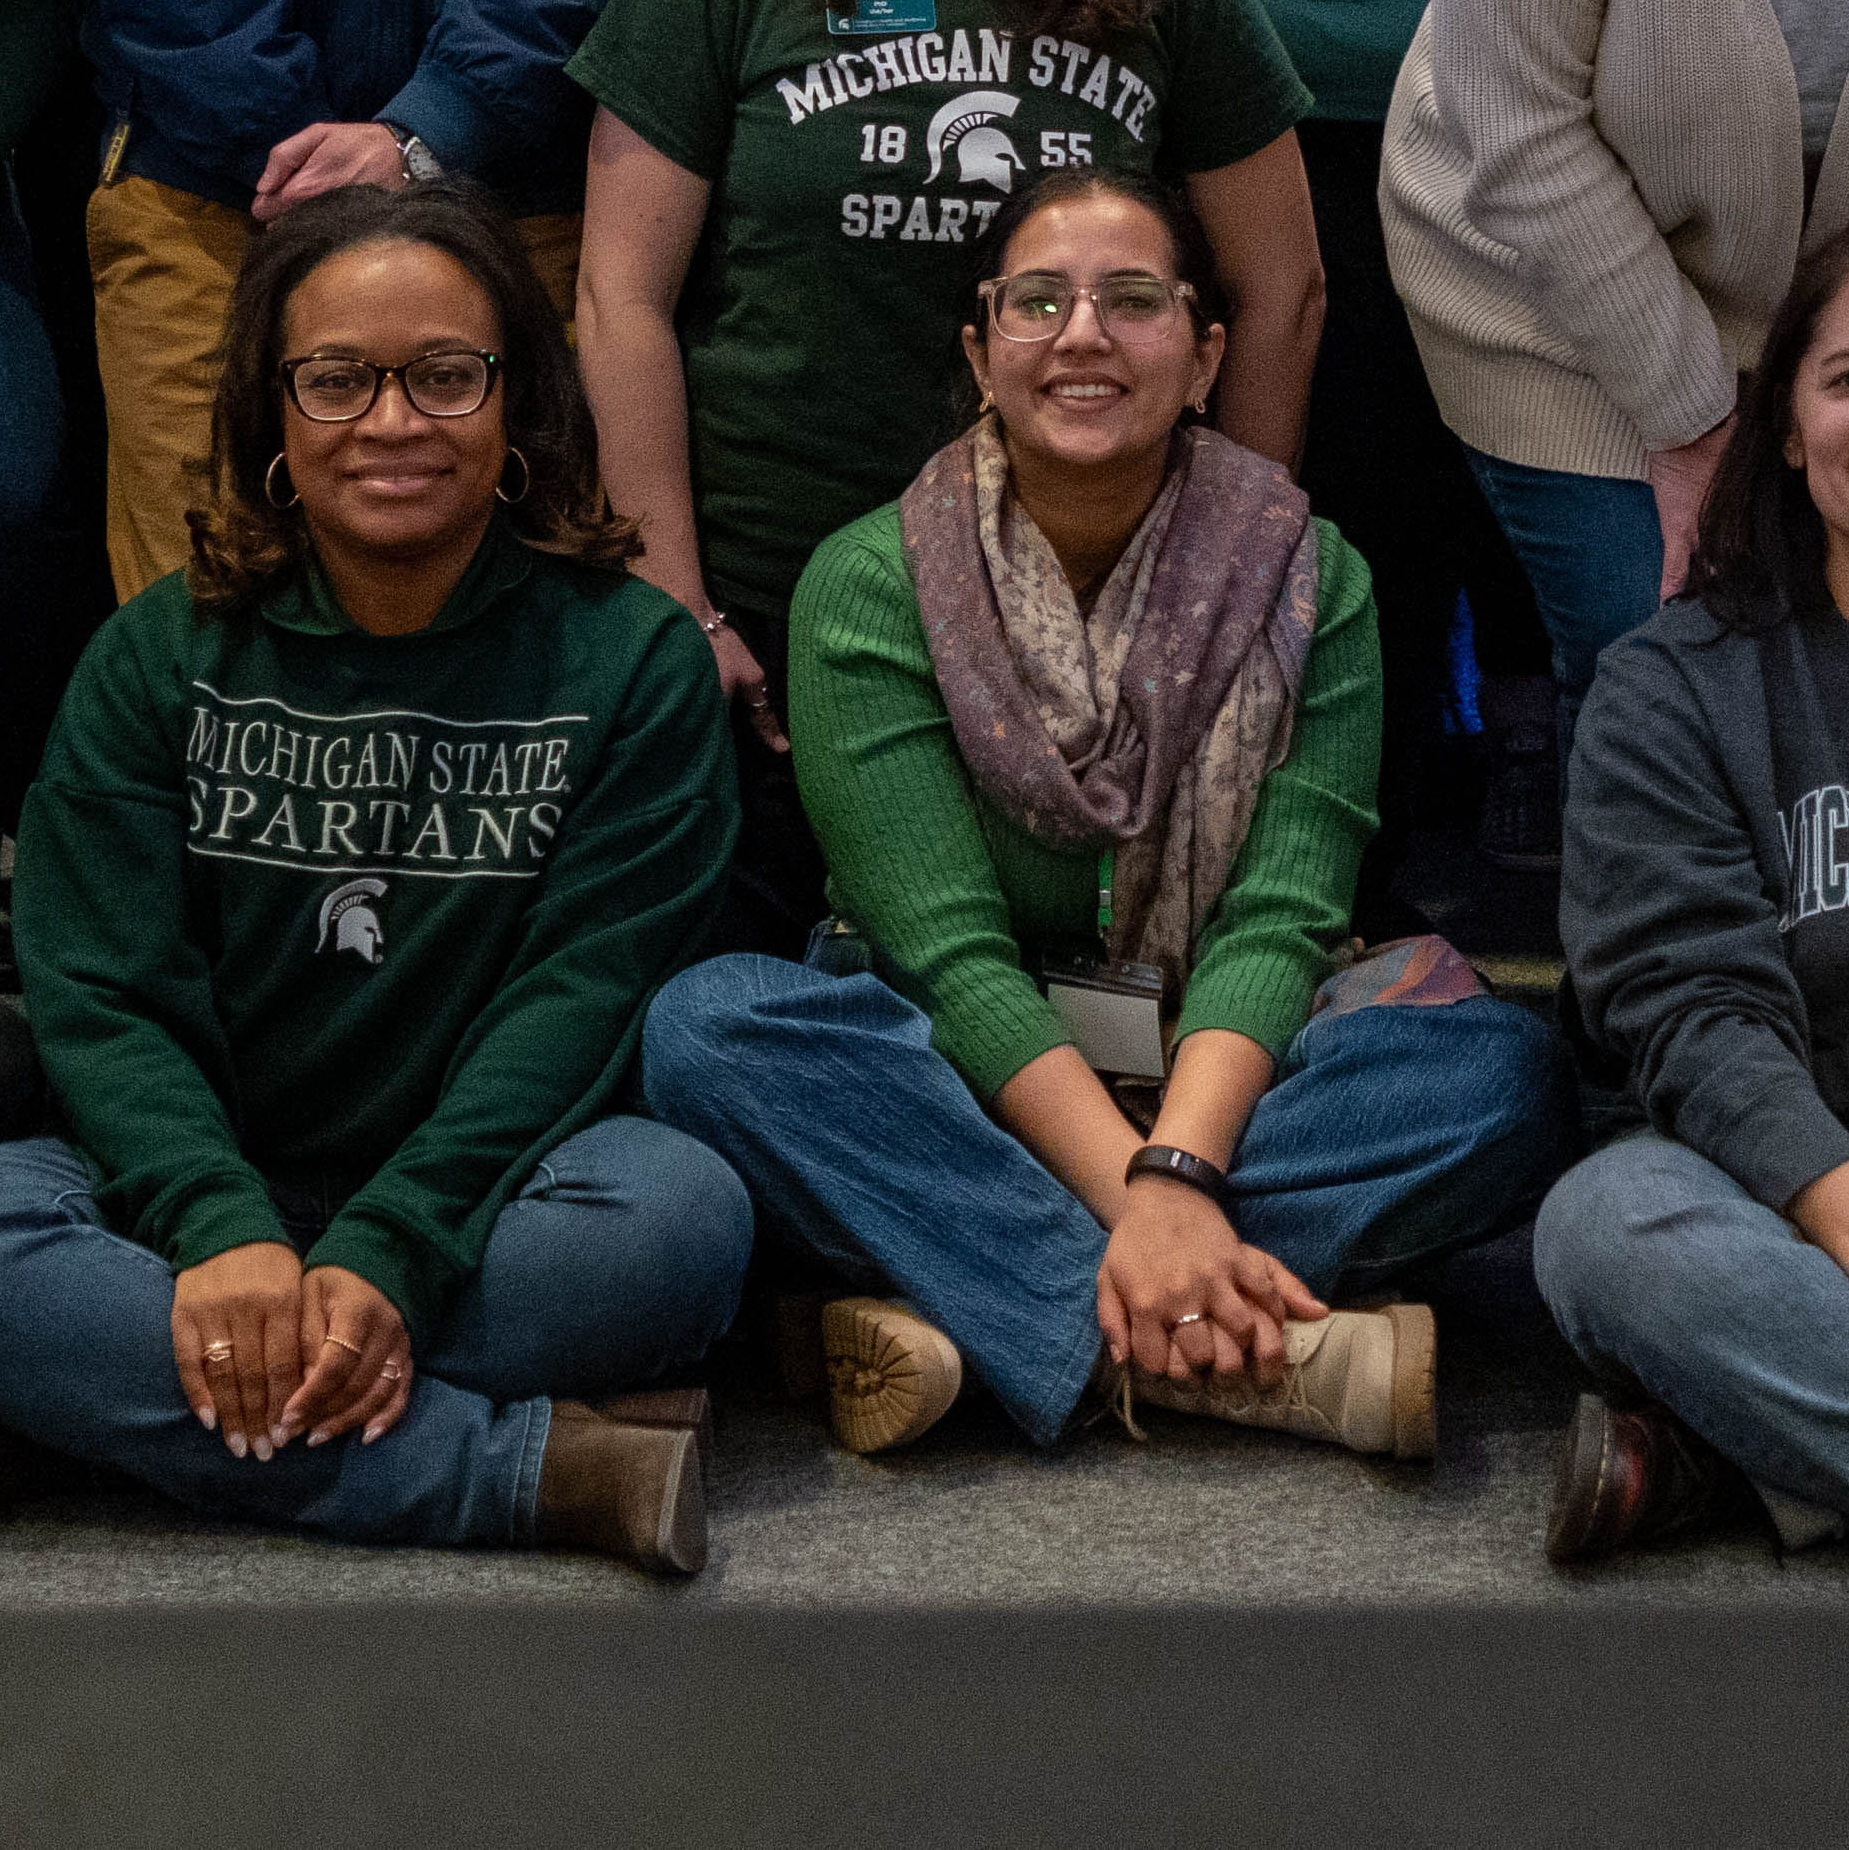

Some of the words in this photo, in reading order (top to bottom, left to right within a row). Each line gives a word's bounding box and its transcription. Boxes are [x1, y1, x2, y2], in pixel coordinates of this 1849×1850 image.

[775, 27, 1013, 124] MICHIGAN
[1030, 34, 1156, 142] STATE
[859, 124, 906, 164] 18
[1040, 131, 1093, 169] 55
[840, 193, 1000, 242] SPART
[186, 706, 418, 791] MICHIGAN
[430, 738, 568, 795] STATE
[187, 775, 562, 860] SPARTANS
